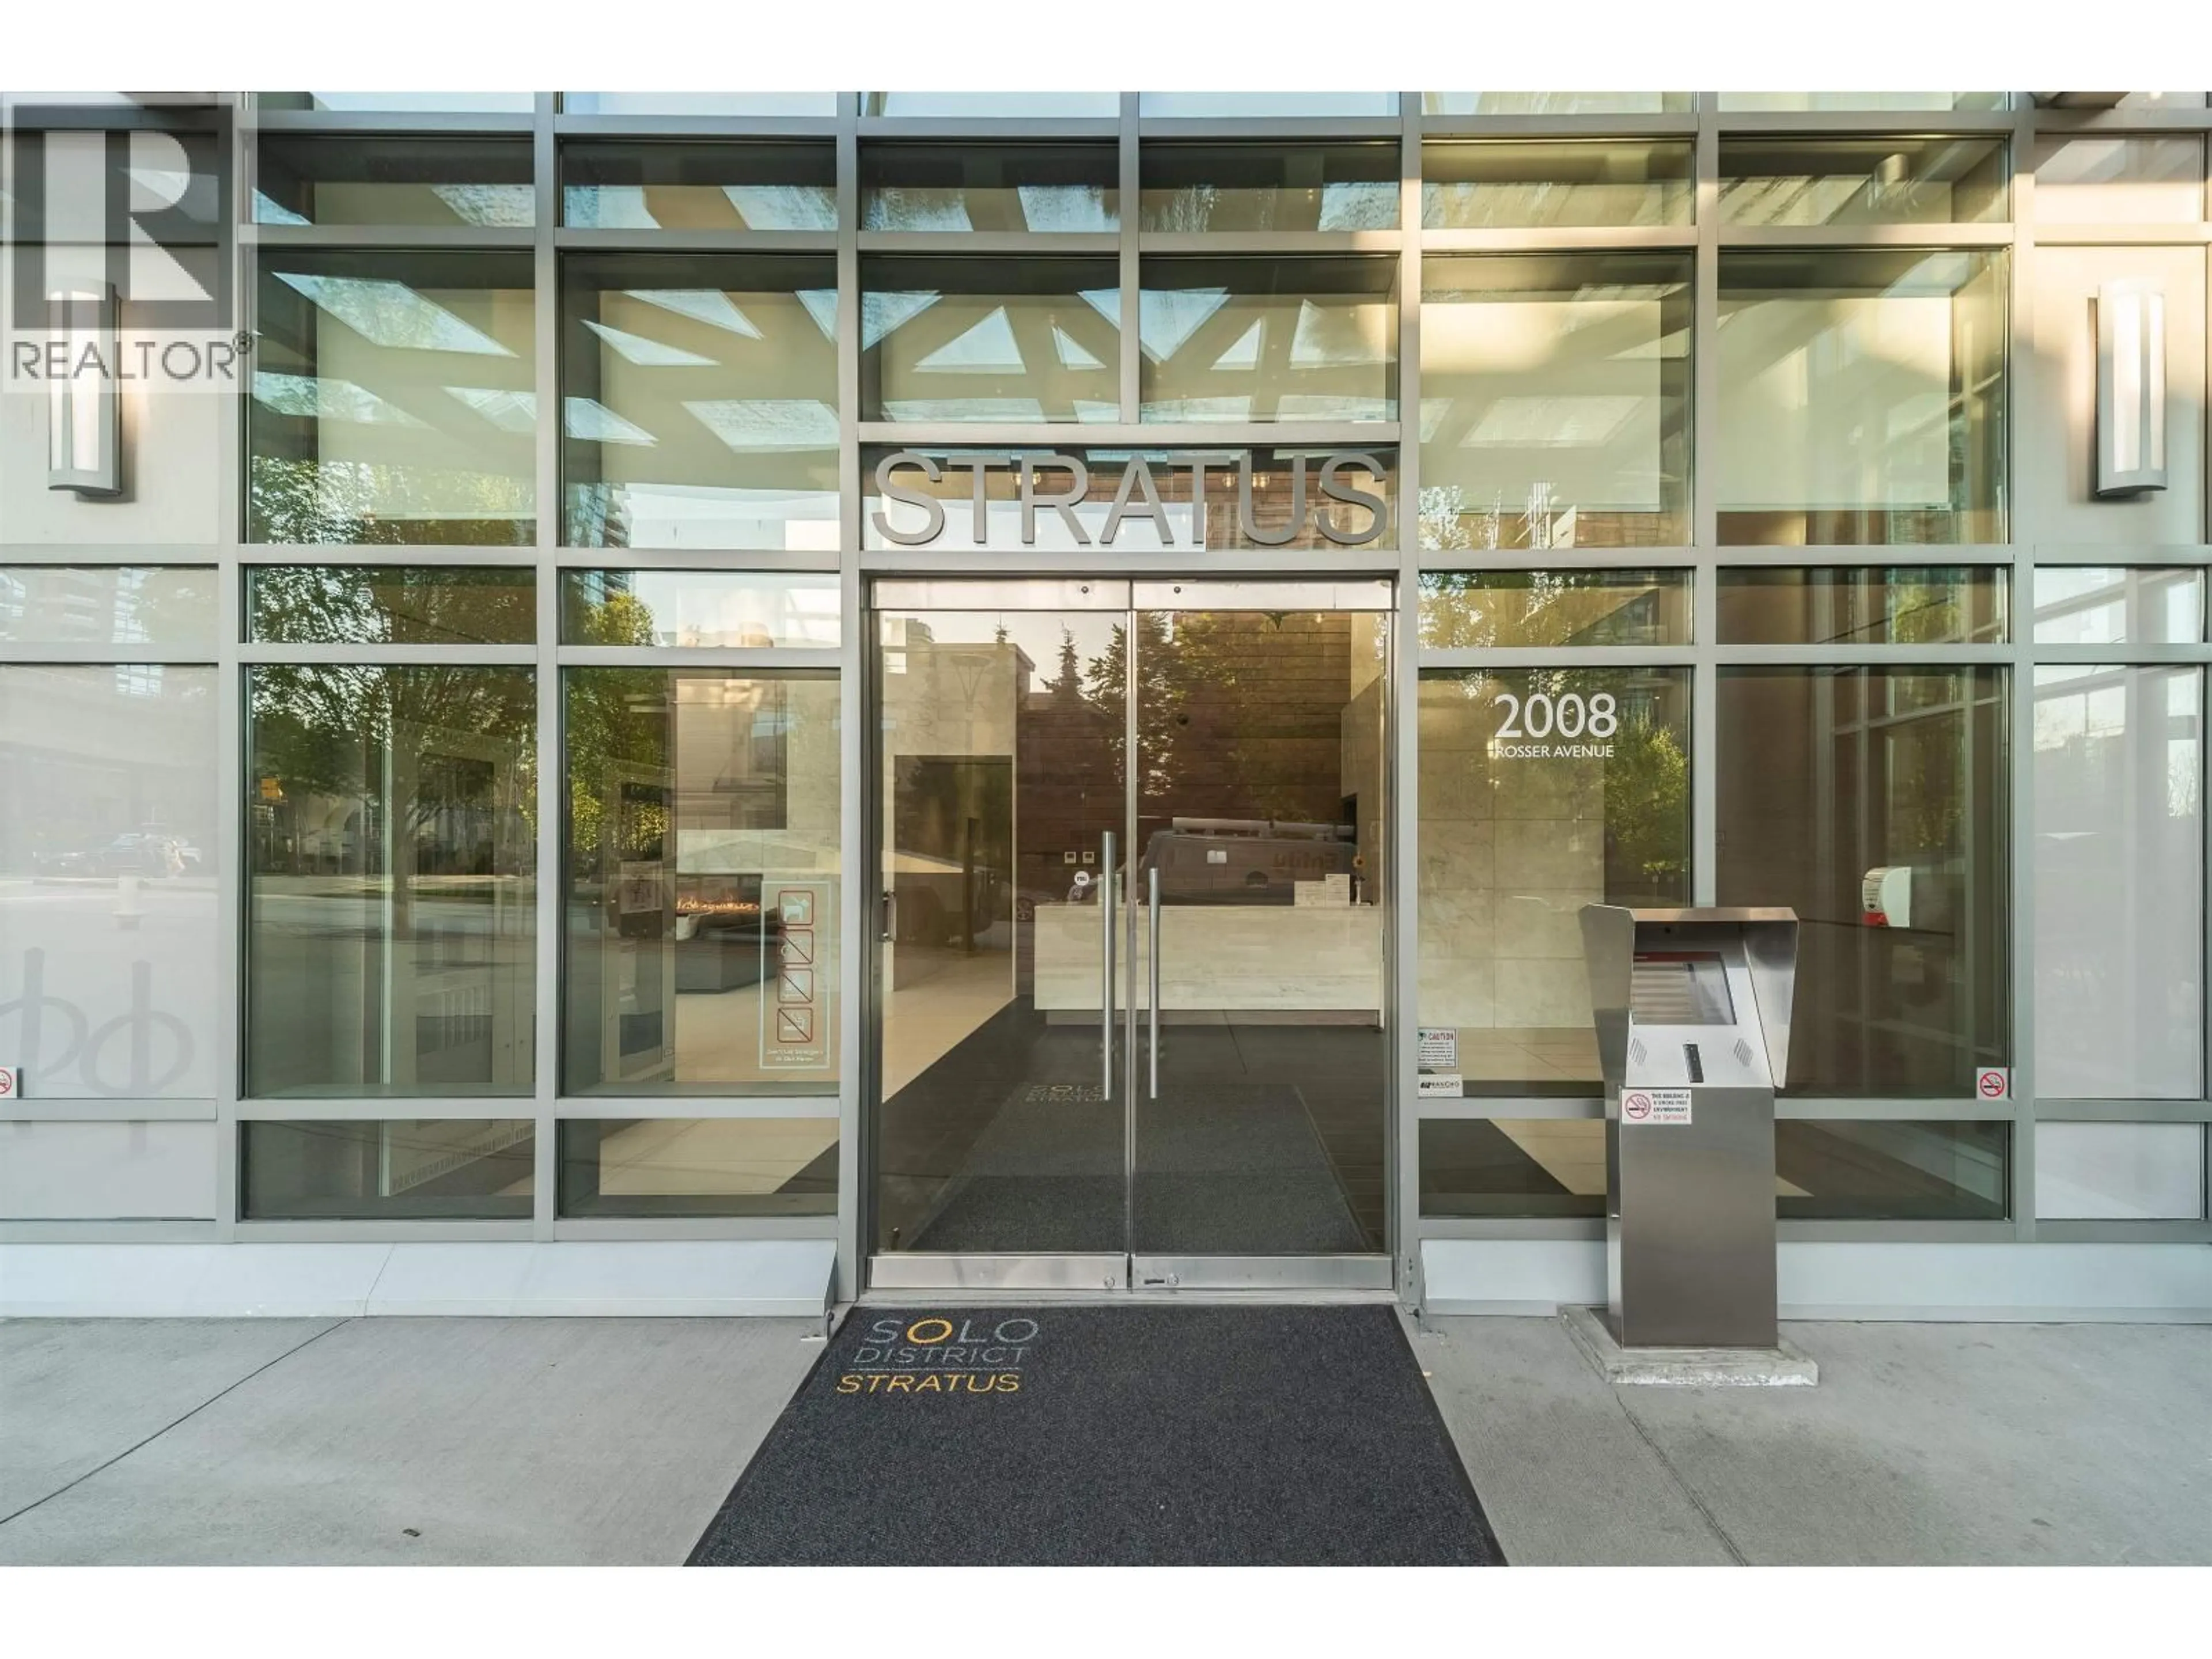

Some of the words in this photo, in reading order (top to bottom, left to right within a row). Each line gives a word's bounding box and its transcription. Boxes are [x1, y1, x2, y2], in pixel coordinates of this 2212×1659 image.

[872, 452, 1387, 546] STRATUS
[1494, 693, 1618, 738] 2008
[1495, 745, 1550, 757] ROSSER
[1554, 745, 1614, 757] AVENUE
[865, 1317, 1039, 1344] SOLO
[854, 1347, 1031, 1363] DISTRICT
[836, 1373, 1020, 1393] STRATUS
